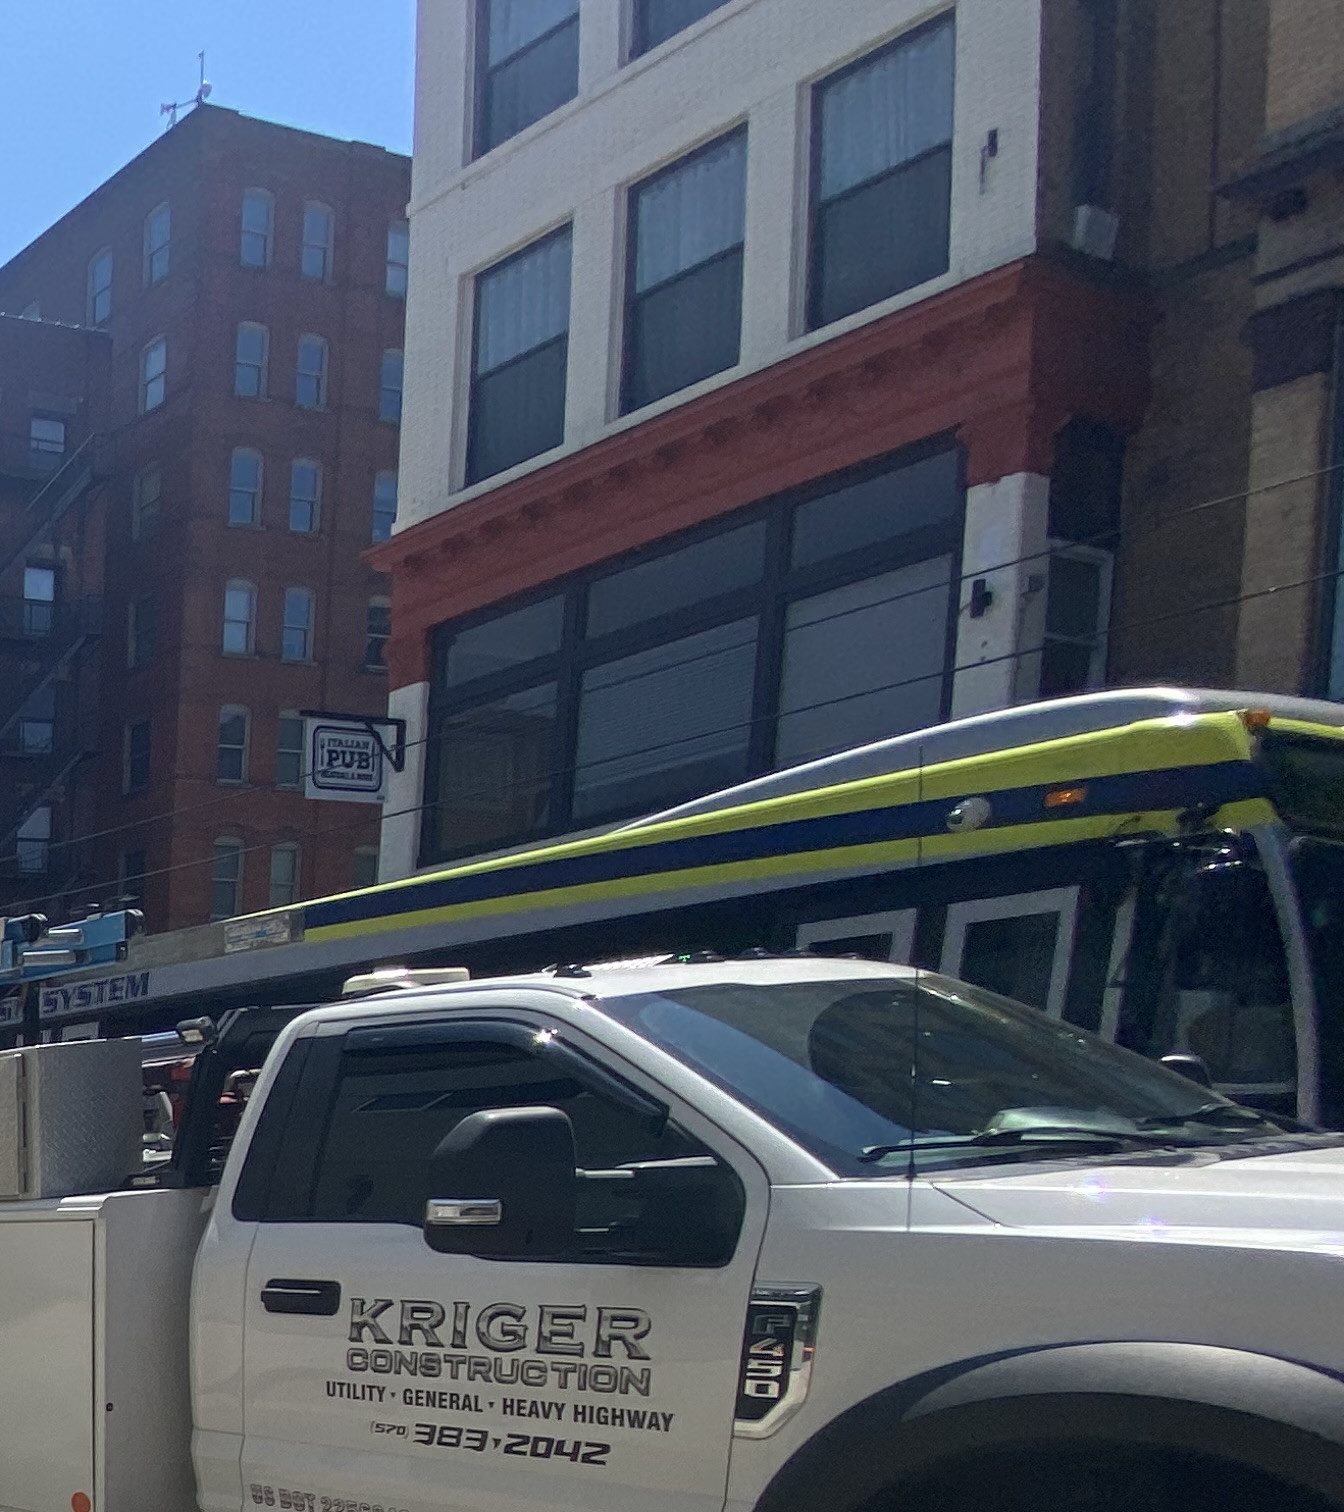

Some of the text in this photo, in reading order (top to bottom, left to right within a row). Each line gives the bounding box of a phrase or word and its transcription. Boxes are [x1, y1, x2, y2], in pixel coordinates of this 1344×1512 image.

[326, 749, 371, 769] PUB
[327, 738, 370, 751] ITALIAN
[43, 972, 150, 1014] SYSTEM
[347, 1298, 652, 1361] KRIGER
[346, 1348, 652, 1397] CONSTRUCTION
[326, 1381, 674, 1433] UTILITY GENERAL HEAVY HIGHWAY
[370, 1420, 410, 1440] (570)
[250, 1483, 275, 1506] US
